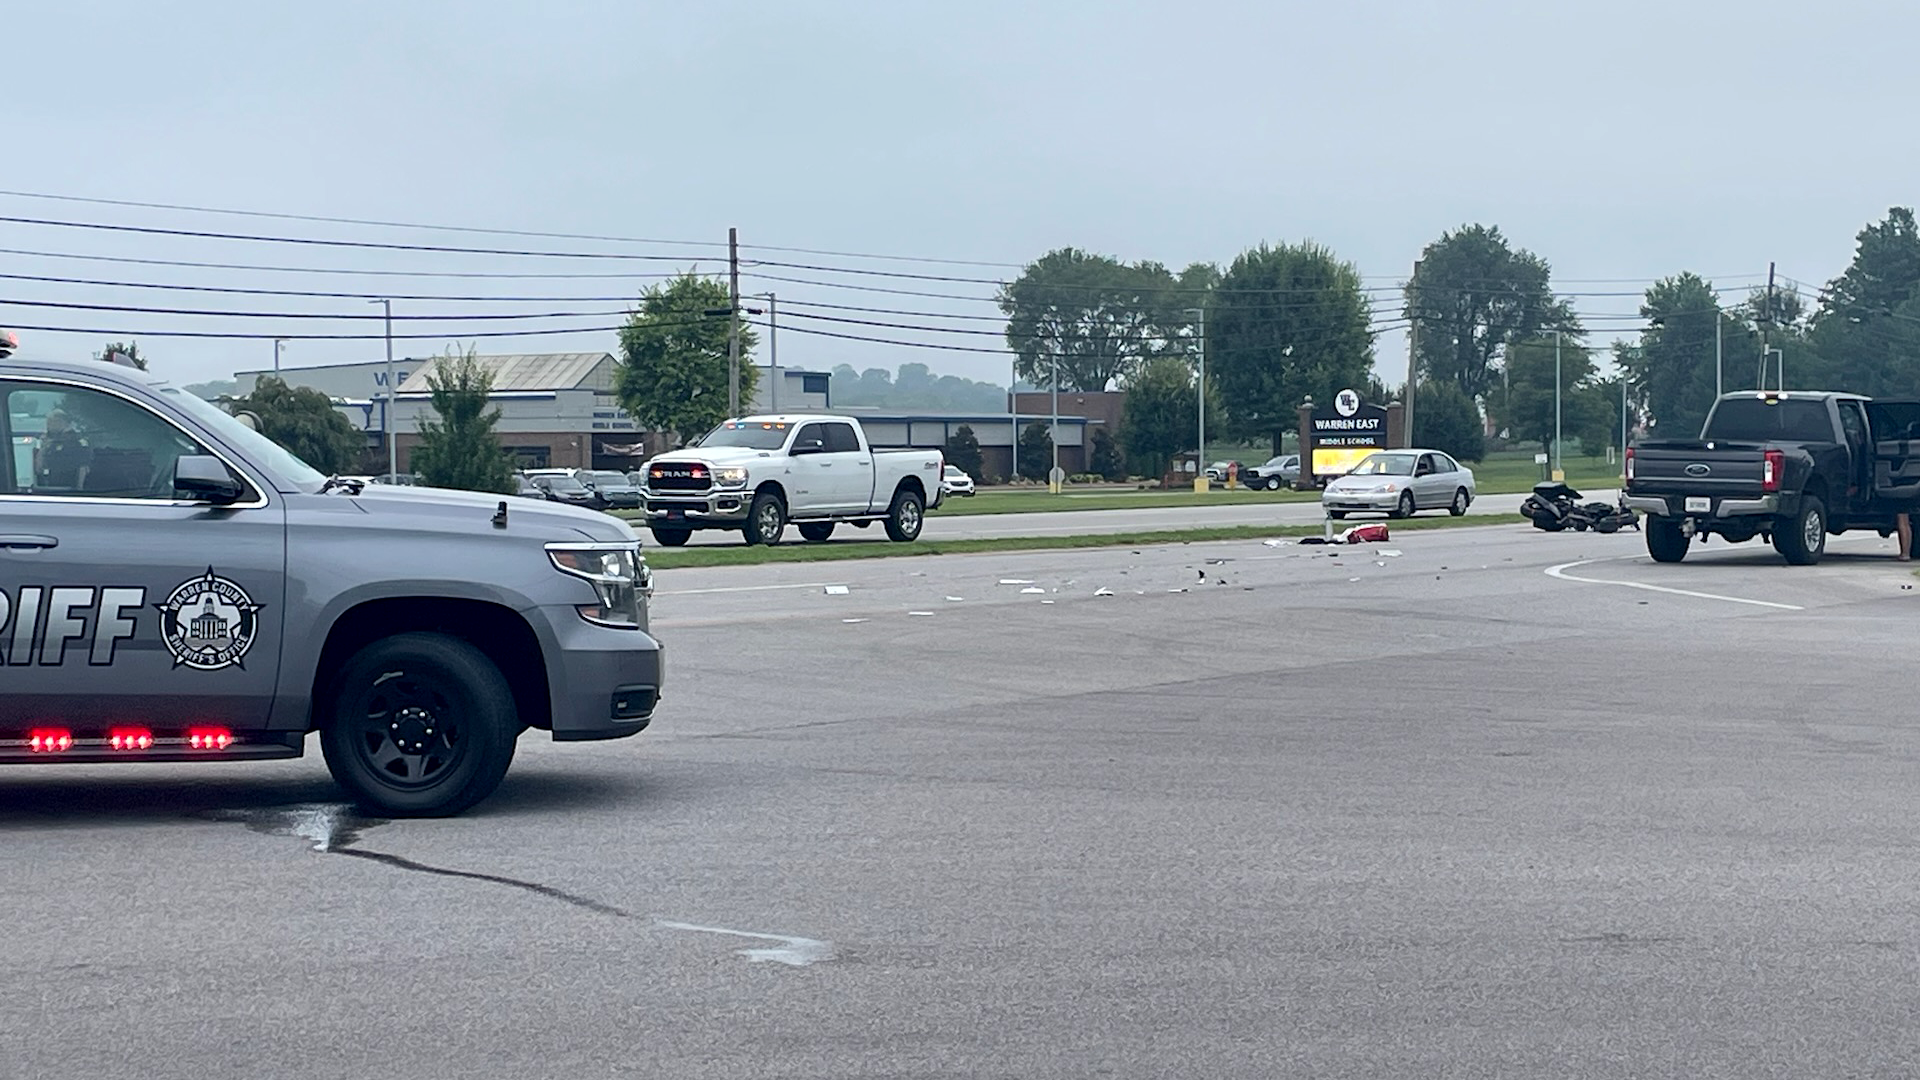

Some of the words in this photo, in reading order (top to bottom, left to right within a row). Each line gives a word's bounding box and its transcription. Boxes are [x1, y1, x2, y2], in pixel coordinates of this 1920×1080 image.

[1315, 420, 1355, 430] WARREN
[1356, 419, 1379, 429] EAST
[169, 582, 209, 610] WARREN
[212, 582, 248, 610] COUNTY
[0, 586, 146, 666] IFF
[169, 634, 215, 664] SHERIFF'S
[218, 634, 248, 663] OFFICE
